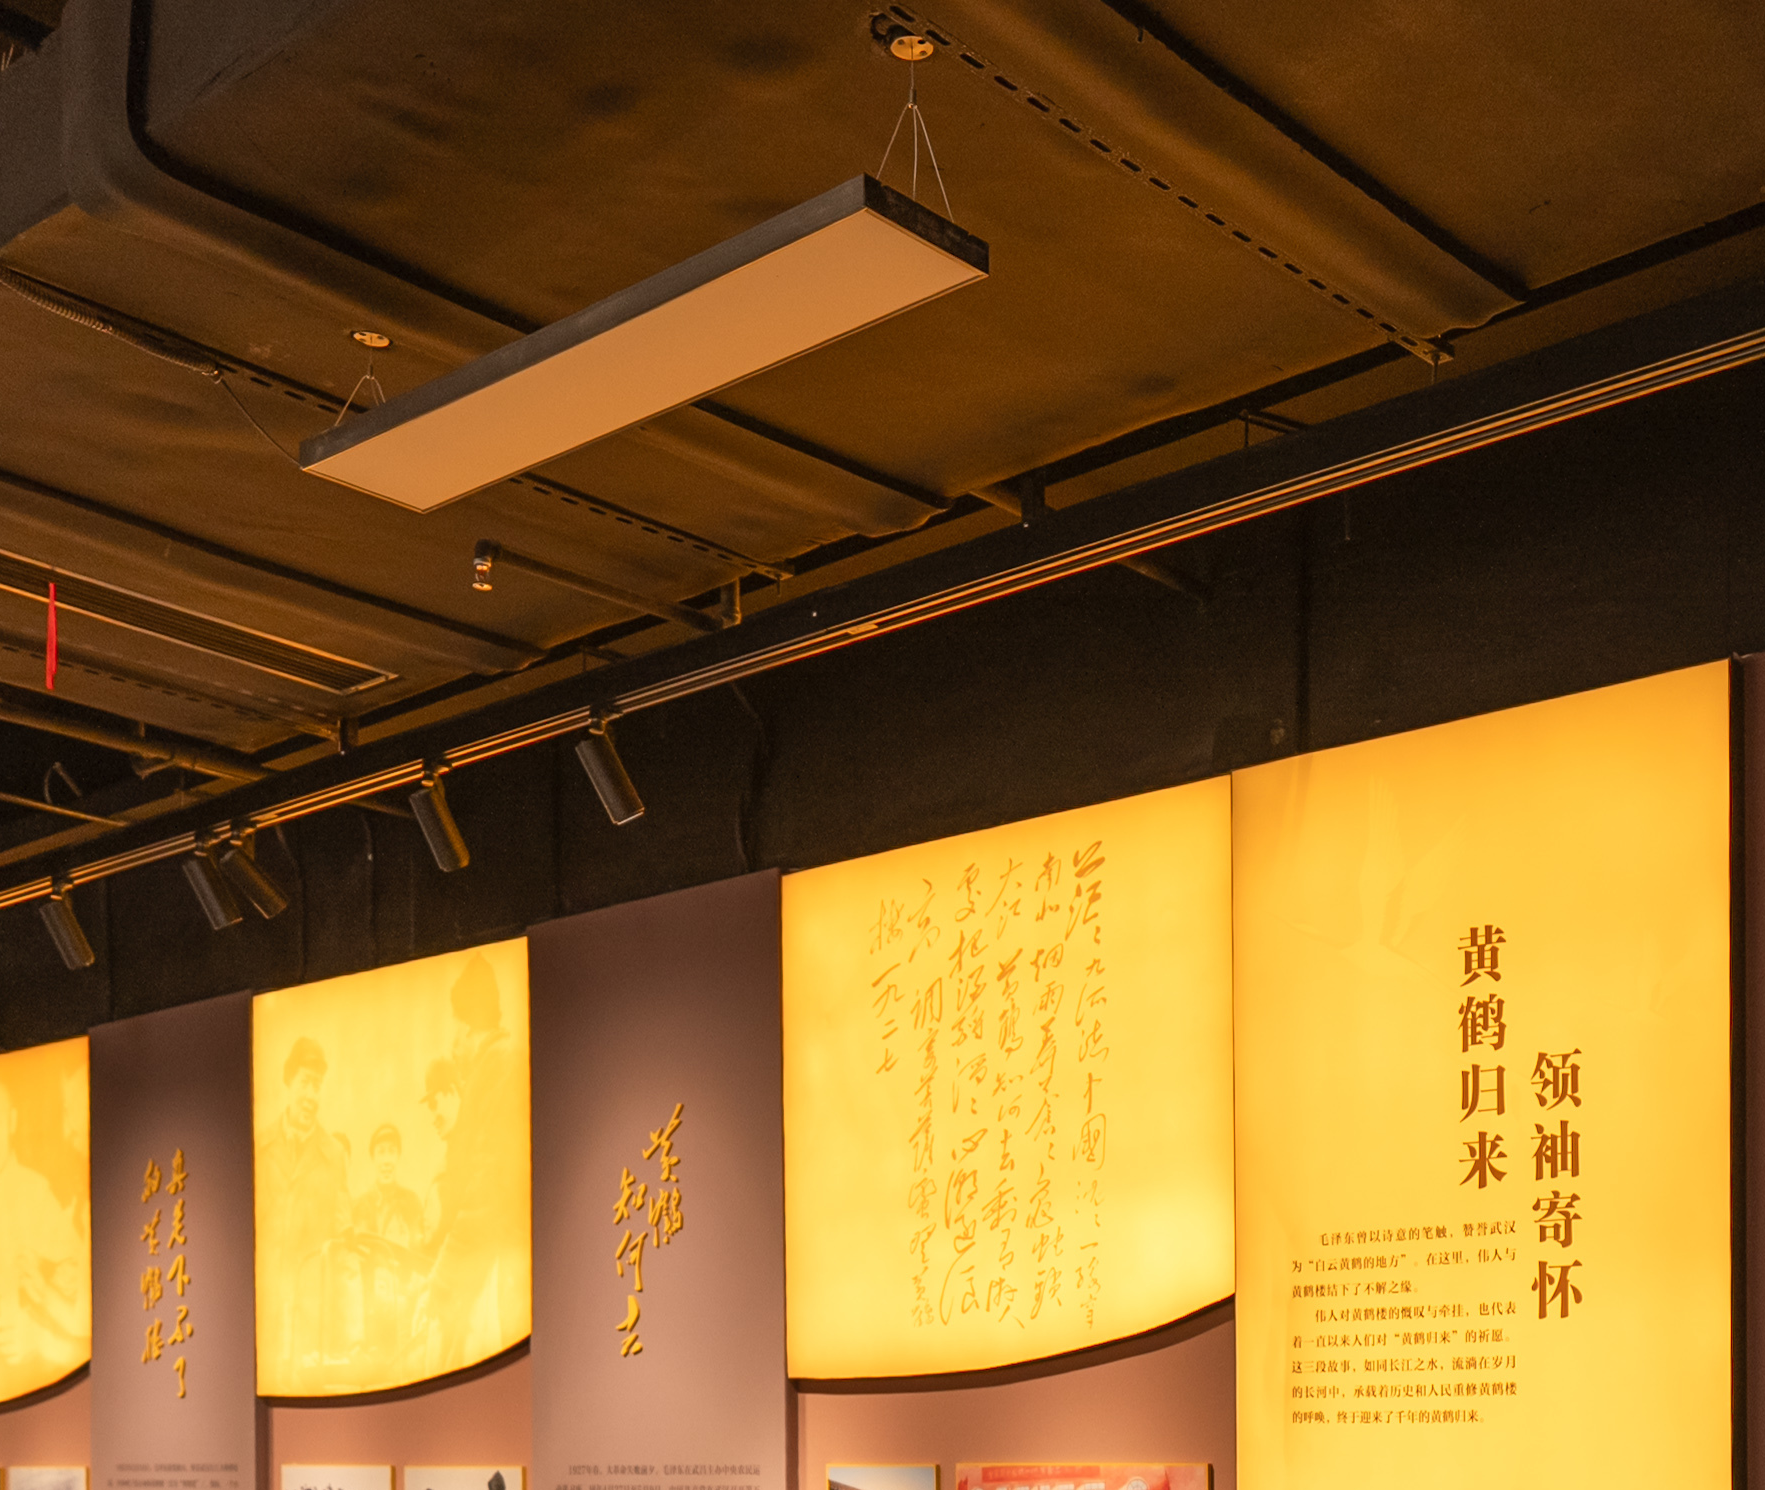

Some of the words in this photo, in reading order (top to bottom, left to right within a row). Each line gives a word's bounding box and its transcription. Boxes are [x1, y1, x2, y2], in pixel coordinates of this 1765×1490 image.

[1458, 924, 1509, 1189] 黄鹤归来
[1530, 1047, 1583, 1320] 领袖寄怀
